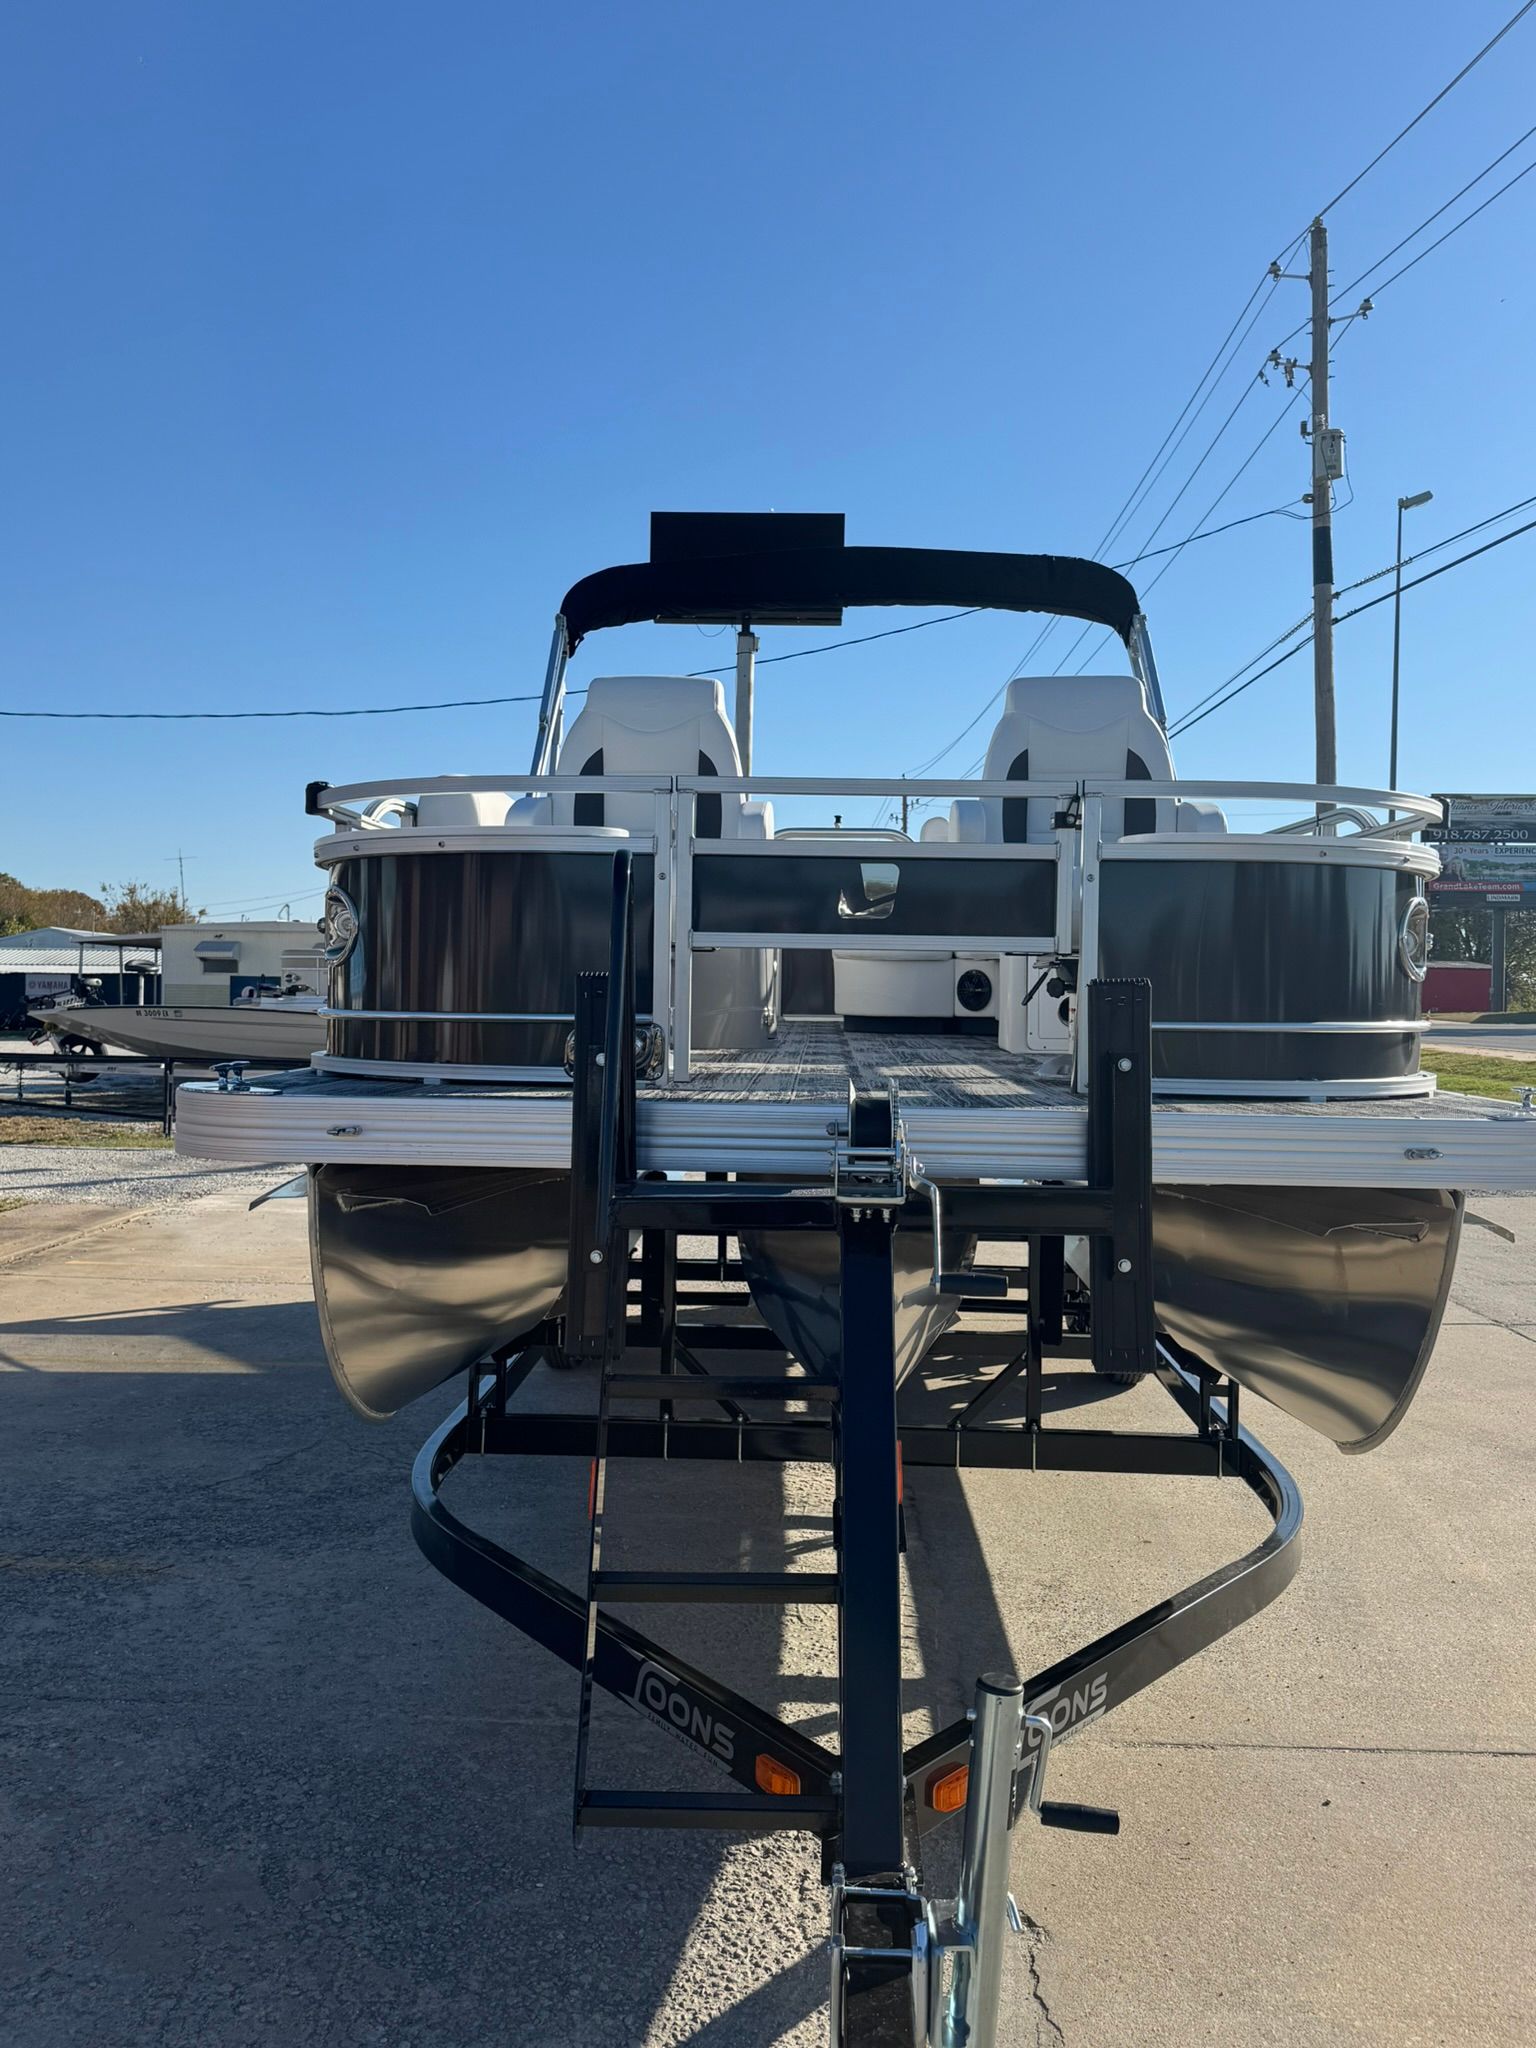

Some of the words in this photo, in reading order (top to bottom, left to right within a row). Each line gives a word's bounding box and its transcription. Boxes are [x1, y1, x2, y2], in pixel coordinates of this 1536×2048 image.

[1432, 829, 1529, 840] 918.787.2500
[1469, 847, 1489, 855] Years
[1433, 882, 1520, 891] GrandLakeTeam.com
[37, 980, 69, 990] YAMAHA
